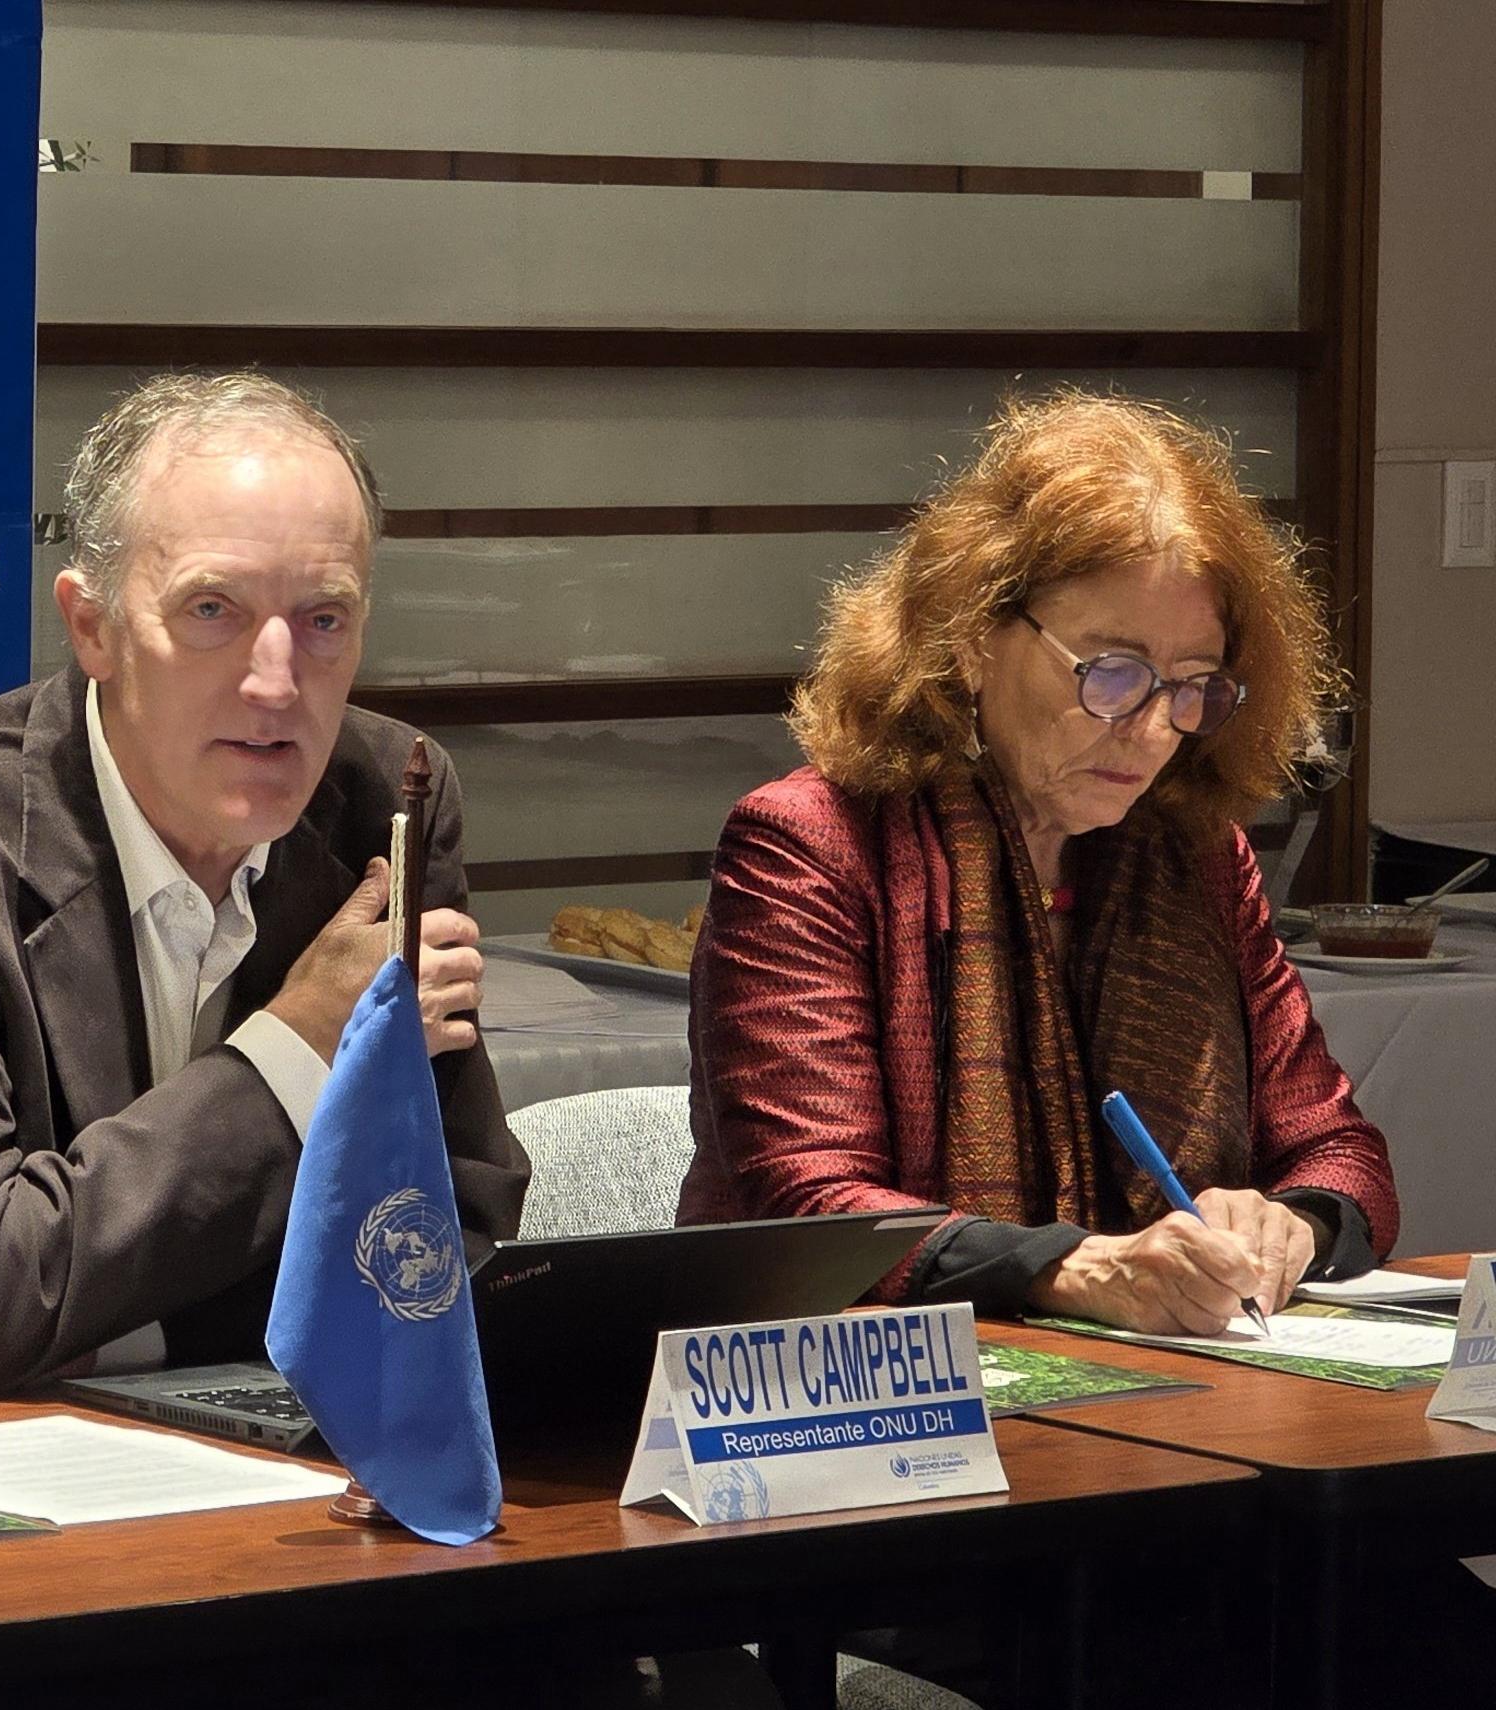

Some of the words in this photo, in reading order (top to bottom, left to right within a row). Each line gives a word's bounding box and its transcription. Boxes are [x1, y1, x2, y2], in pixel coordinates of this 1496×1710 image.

[488, 1261, 551, 1292] ThinkPad
[685, 1328, 790, 1419] SCOTT
[798, 1312, 967, 1408] CAMPBELL
[722, 1420, 865, 1457] Representante
[869, 1412, 917, 1439] ONU
[921, 1408, 954, 1433] DH
